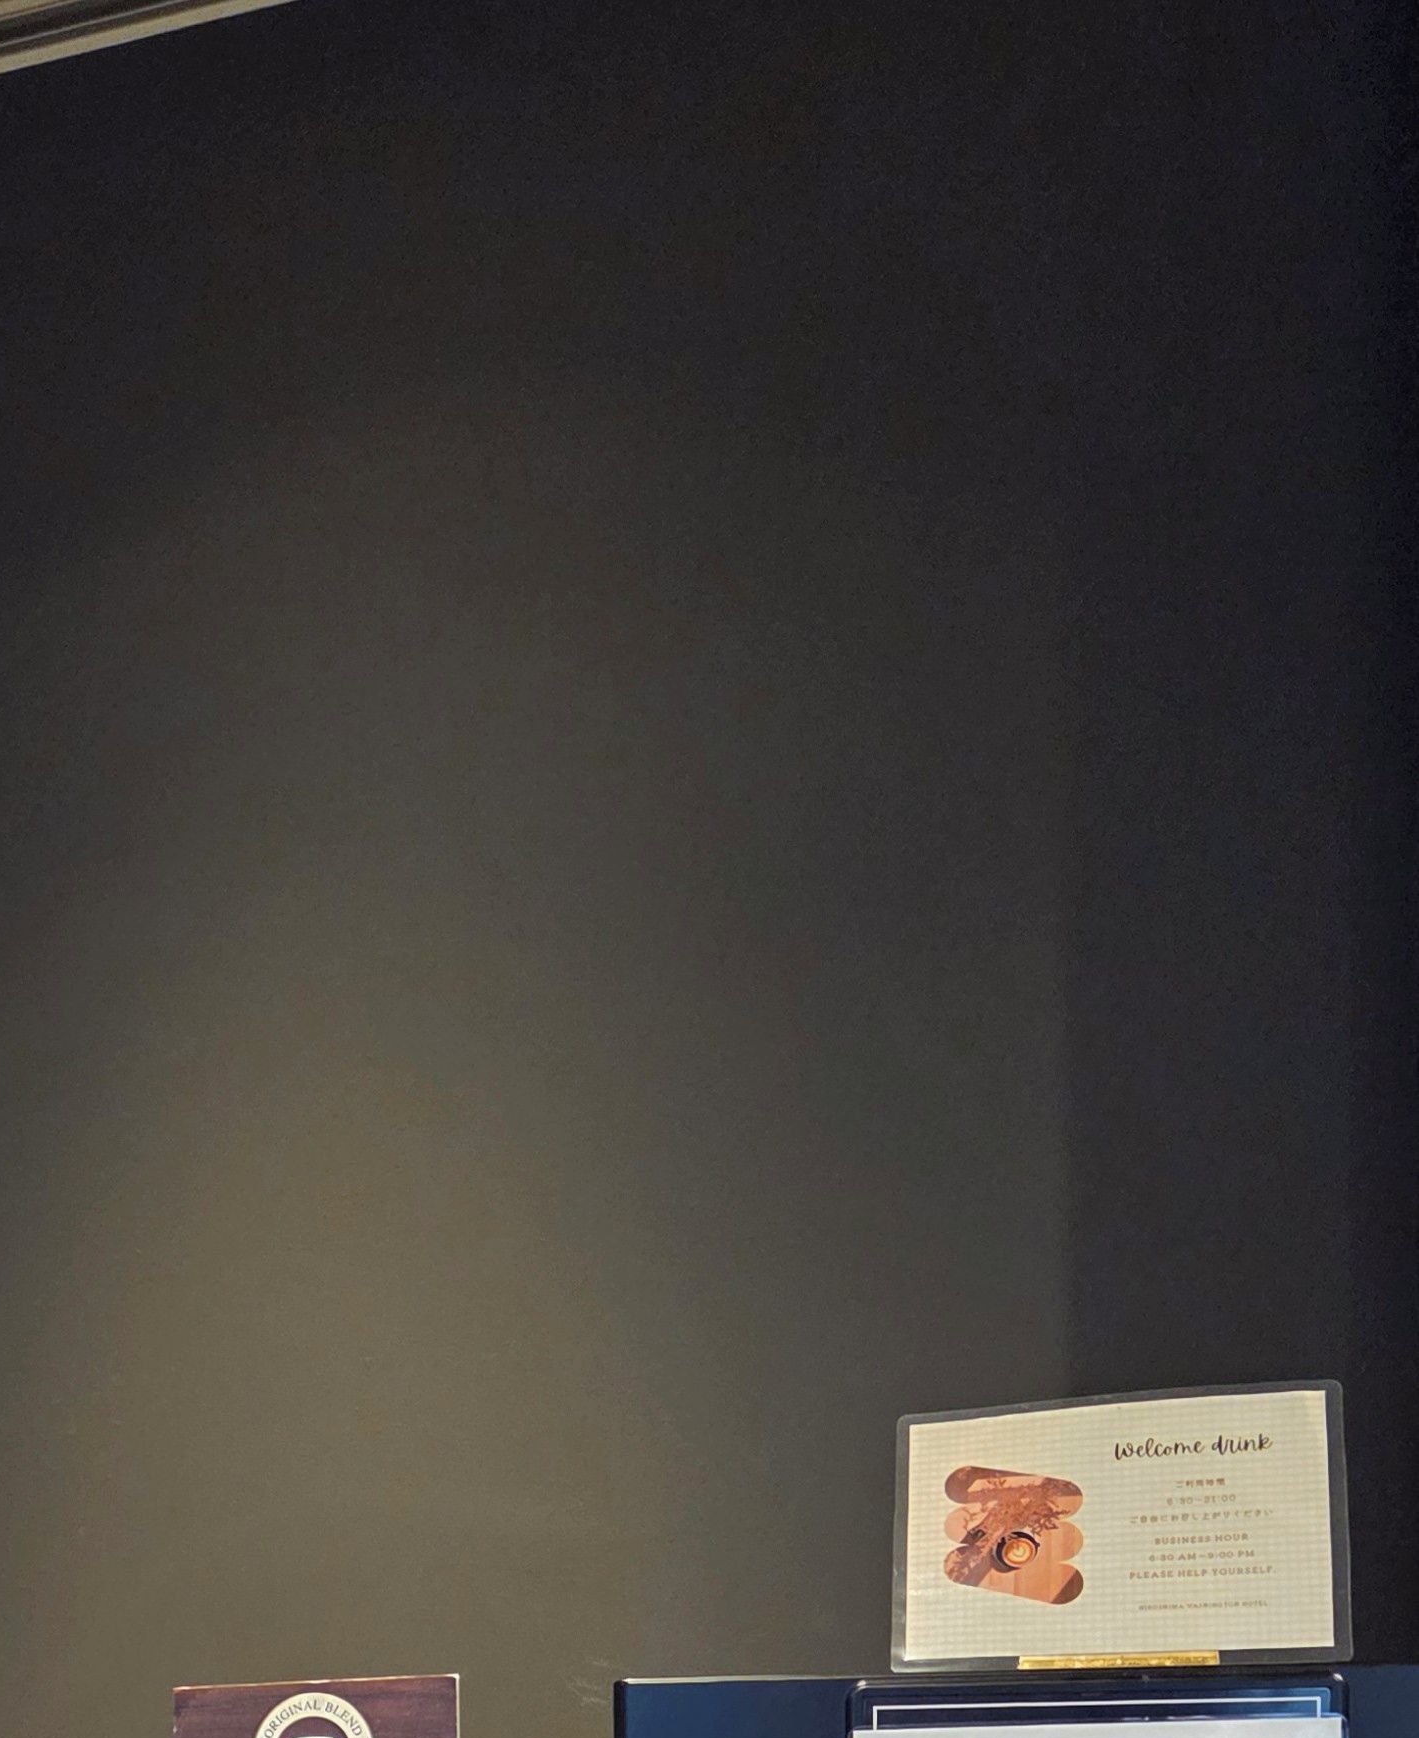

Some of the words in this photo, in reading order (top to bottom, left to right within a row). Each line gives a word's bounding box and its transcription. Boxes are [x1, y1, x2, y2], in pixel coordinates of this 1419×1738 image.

[1114, 1437, 1204, 1461] Welcome
[1211, 1433, 1273, 1456] drink
[1154, 1535, 1211, 1545] BUSINESS
[1129, 1570, 1174, 1580] PLEASE
[1177, 1568, 1208, 1578] HELP
[264, 1699, 322, 1738] ORIGINAL
[324, 1701, 362, 1736] BLEND
